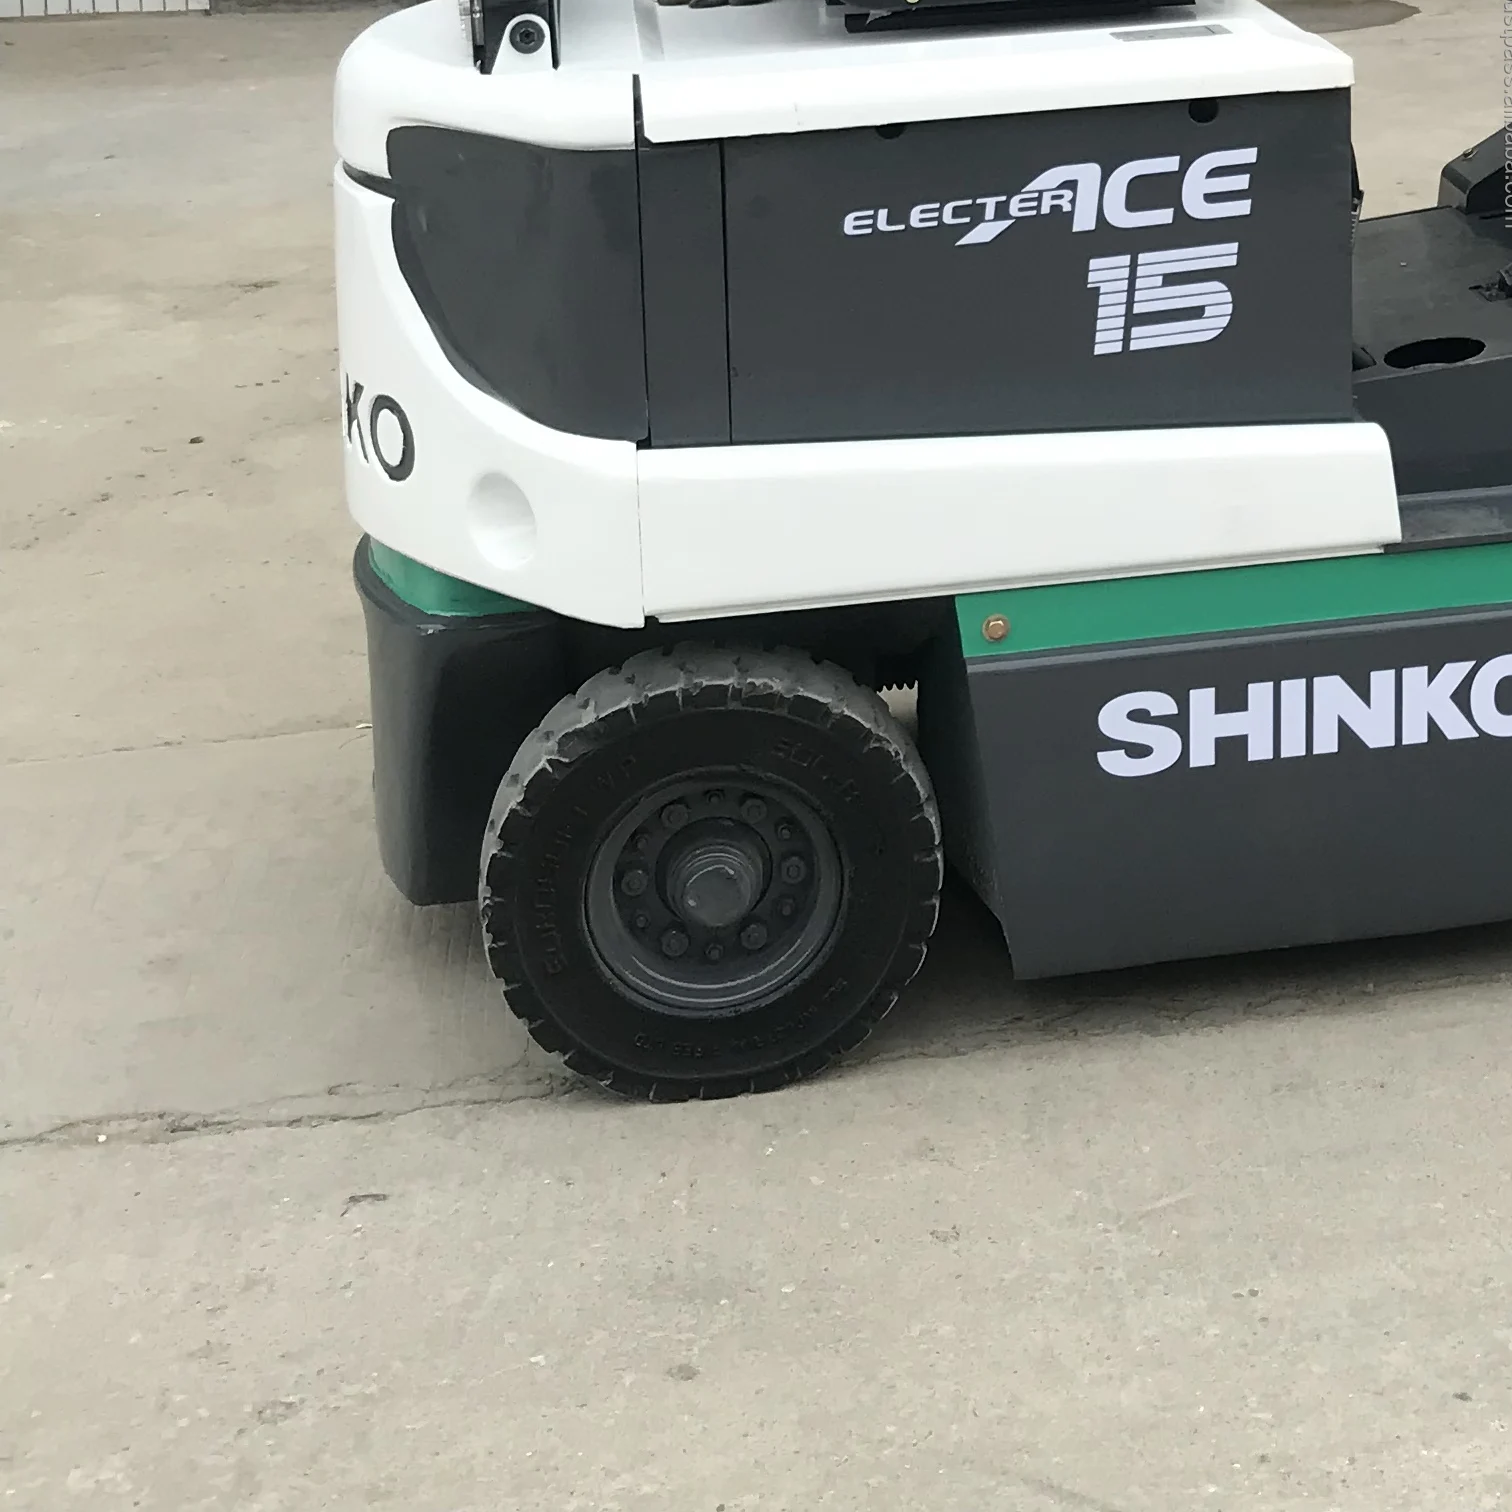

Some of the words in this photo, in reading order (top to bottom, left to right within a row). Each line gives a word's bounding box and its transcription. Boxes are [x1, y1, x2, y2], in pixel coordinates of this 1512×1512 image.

[843, 189, 1073, 236] ELECTER
[1021, 147, 1258, 233] ACE
[1087, 242, 1239, 356] 15
